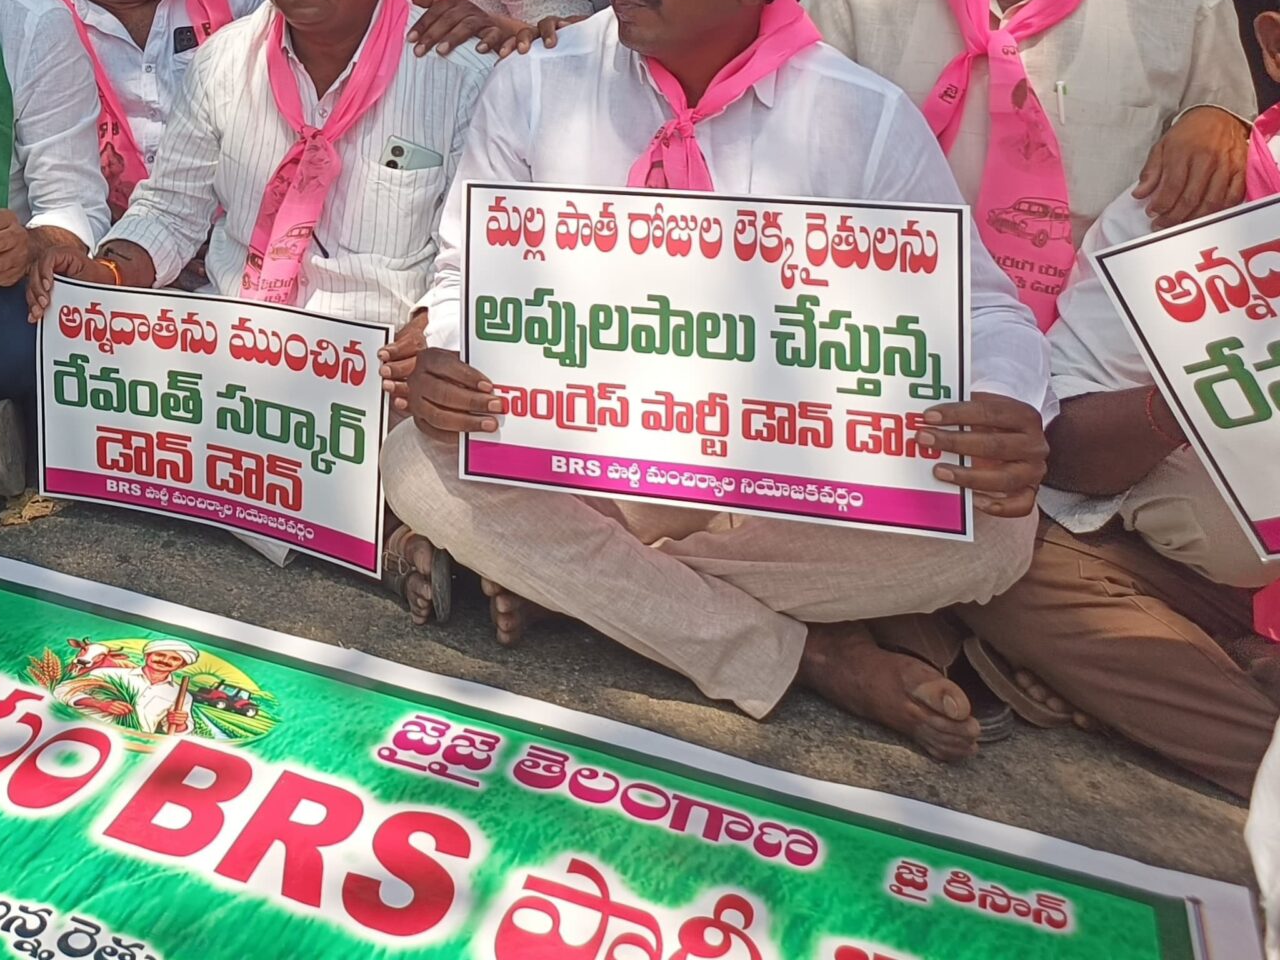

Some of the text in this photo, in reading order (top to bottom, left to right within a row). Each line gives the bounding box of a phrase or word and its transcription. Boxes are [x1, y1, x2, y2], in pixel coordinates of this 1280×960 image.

[485, 196, 939, 290] మల్ల పాత రోజుల లెక్క రైతులను
[58, 302, 367, 386] అన్నదాతను ముంచిన
[474, 288, 952, 401] అప్పులపాలు చేస్తున్న
[53, 353, 366, 475] రేవంత్ సర్కార్
[641, 390, 729, 458] పార్టీ
[741, 398, 833, 450] డౌన్
[96, 425, 303, 512] డౌన్ డౌన్
[106, 480, 315, 541] BRS పార్టీ మంచిర్యాల నియోజకవర్గం
[551, 456, 864, 513] BRS పార్టీ మంచిర్యాల నియోజకవర్గం
[101, 738, 472, 938] BRS
[513, 744, 820, 868] తెలంగాణ
[891, 860, 1071, 931] జై కిసాన్
